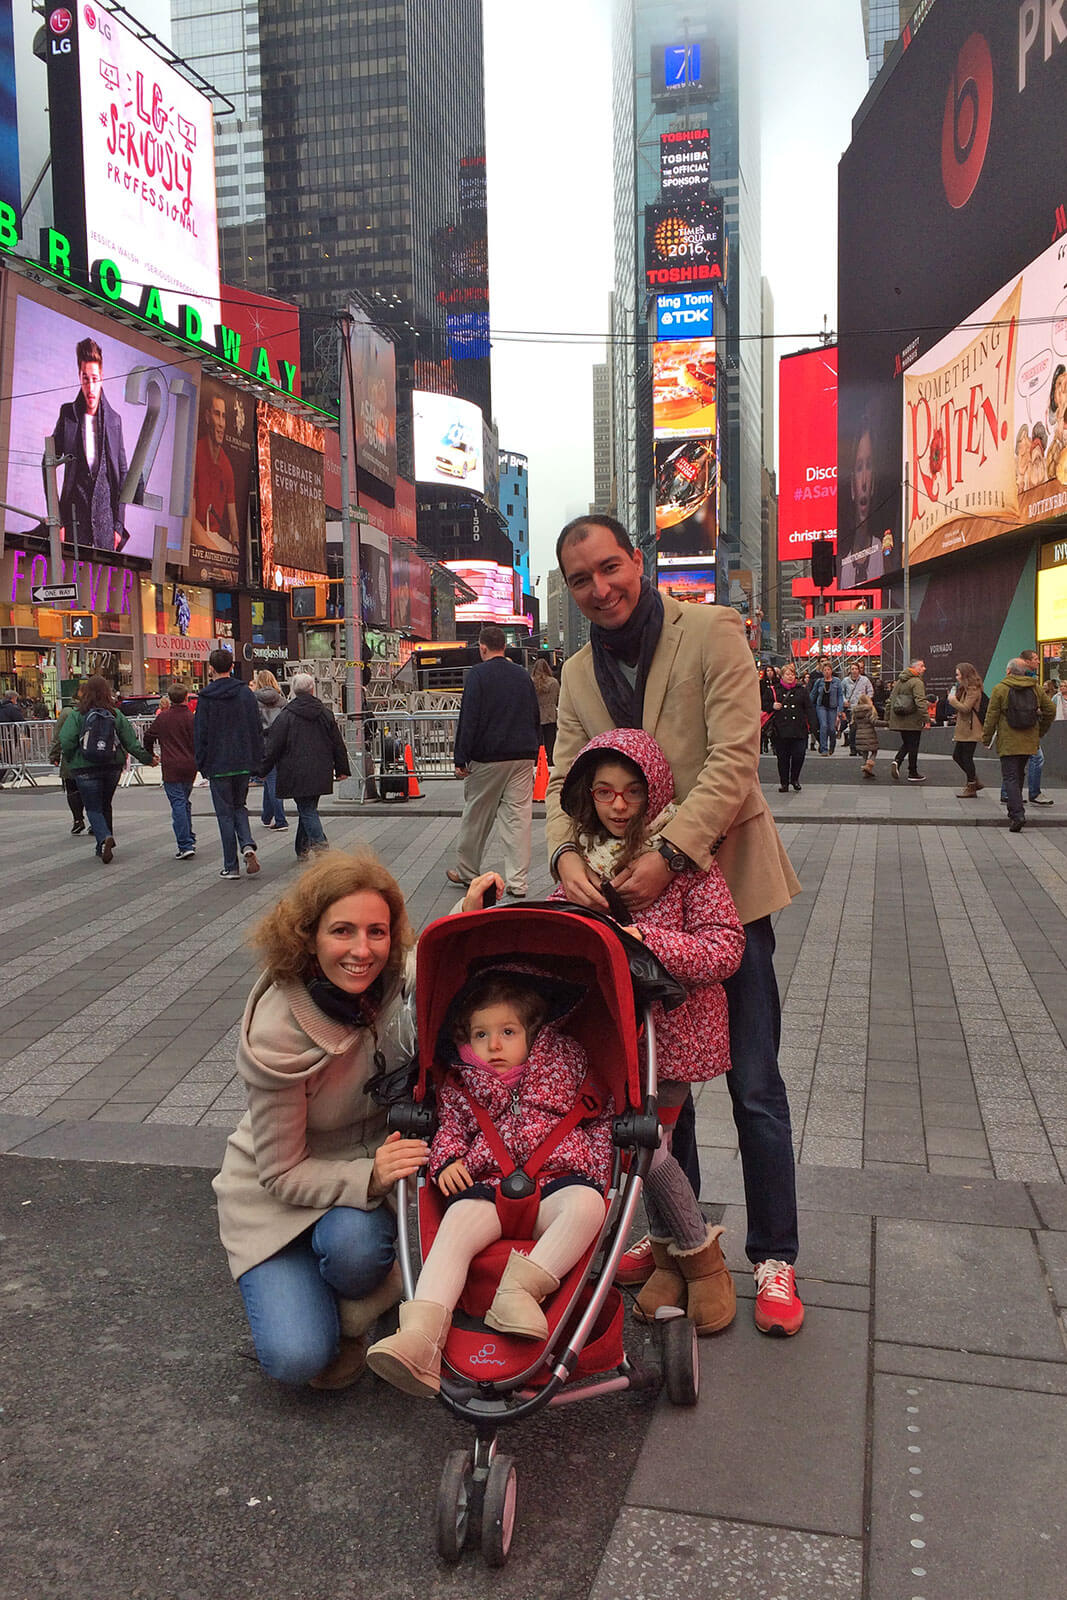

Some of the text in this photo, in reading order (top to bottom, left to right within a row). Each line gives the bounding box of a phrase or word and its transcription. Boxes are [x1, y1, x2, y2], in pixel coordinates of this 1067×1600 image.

[98, 17, 111, 41] LG
[51, 38, 71, 55] LG
[136, 70, 168, 134] LG
[661, 129, 709, 143] TOSHIBA
[99, 103, 193, 215] #SERIOUSLY
[662, 151, 709, 164] TOSHIBA
[673, 163, 706, 175] OFFICIAL
[663, 175, 700, 188] SPONSOR
[107, 162, 198, 238] PROFESSIONAL
[678, 225, 705, 237] TIMES
[684, 232, 717, 244] SQUARE
[668, 242, 704, 257] 2016
[646, 264, 722, 284] TOSHIBA
[0, 203, 298, 394] BROADWAY
[672, 308, 709, 323] TDK
[917, 322, 1001, 404] SOMETHING
[119, 365, 198, 518] 21
[274, 458, 313, 483] CELEBRATE
[314, 472, 322, 486] IN
[675, 462, 692, 479] ARTOIS
[679, 458, 696, 475] STELLA
[275, 474, 322, 501] EVERY SHADE
[921, 510, 939, 534] VERY
[944, 497, 959, 516] NEW
[965, 490, 1006, 508] MUSICAL
[192, 548, 205, 559] LIVE
[11, 550, 133, 614] FOEVER
[155, 636, 170, 649] U.S.
[170, 637, 191, 650] POLO
[930, 643, 953, 654] VORNADO
[101, 651, 112, 669] 21
[170, 651, 186, 659] SINCE
[253, 645, 289, 661] sunglass hut
